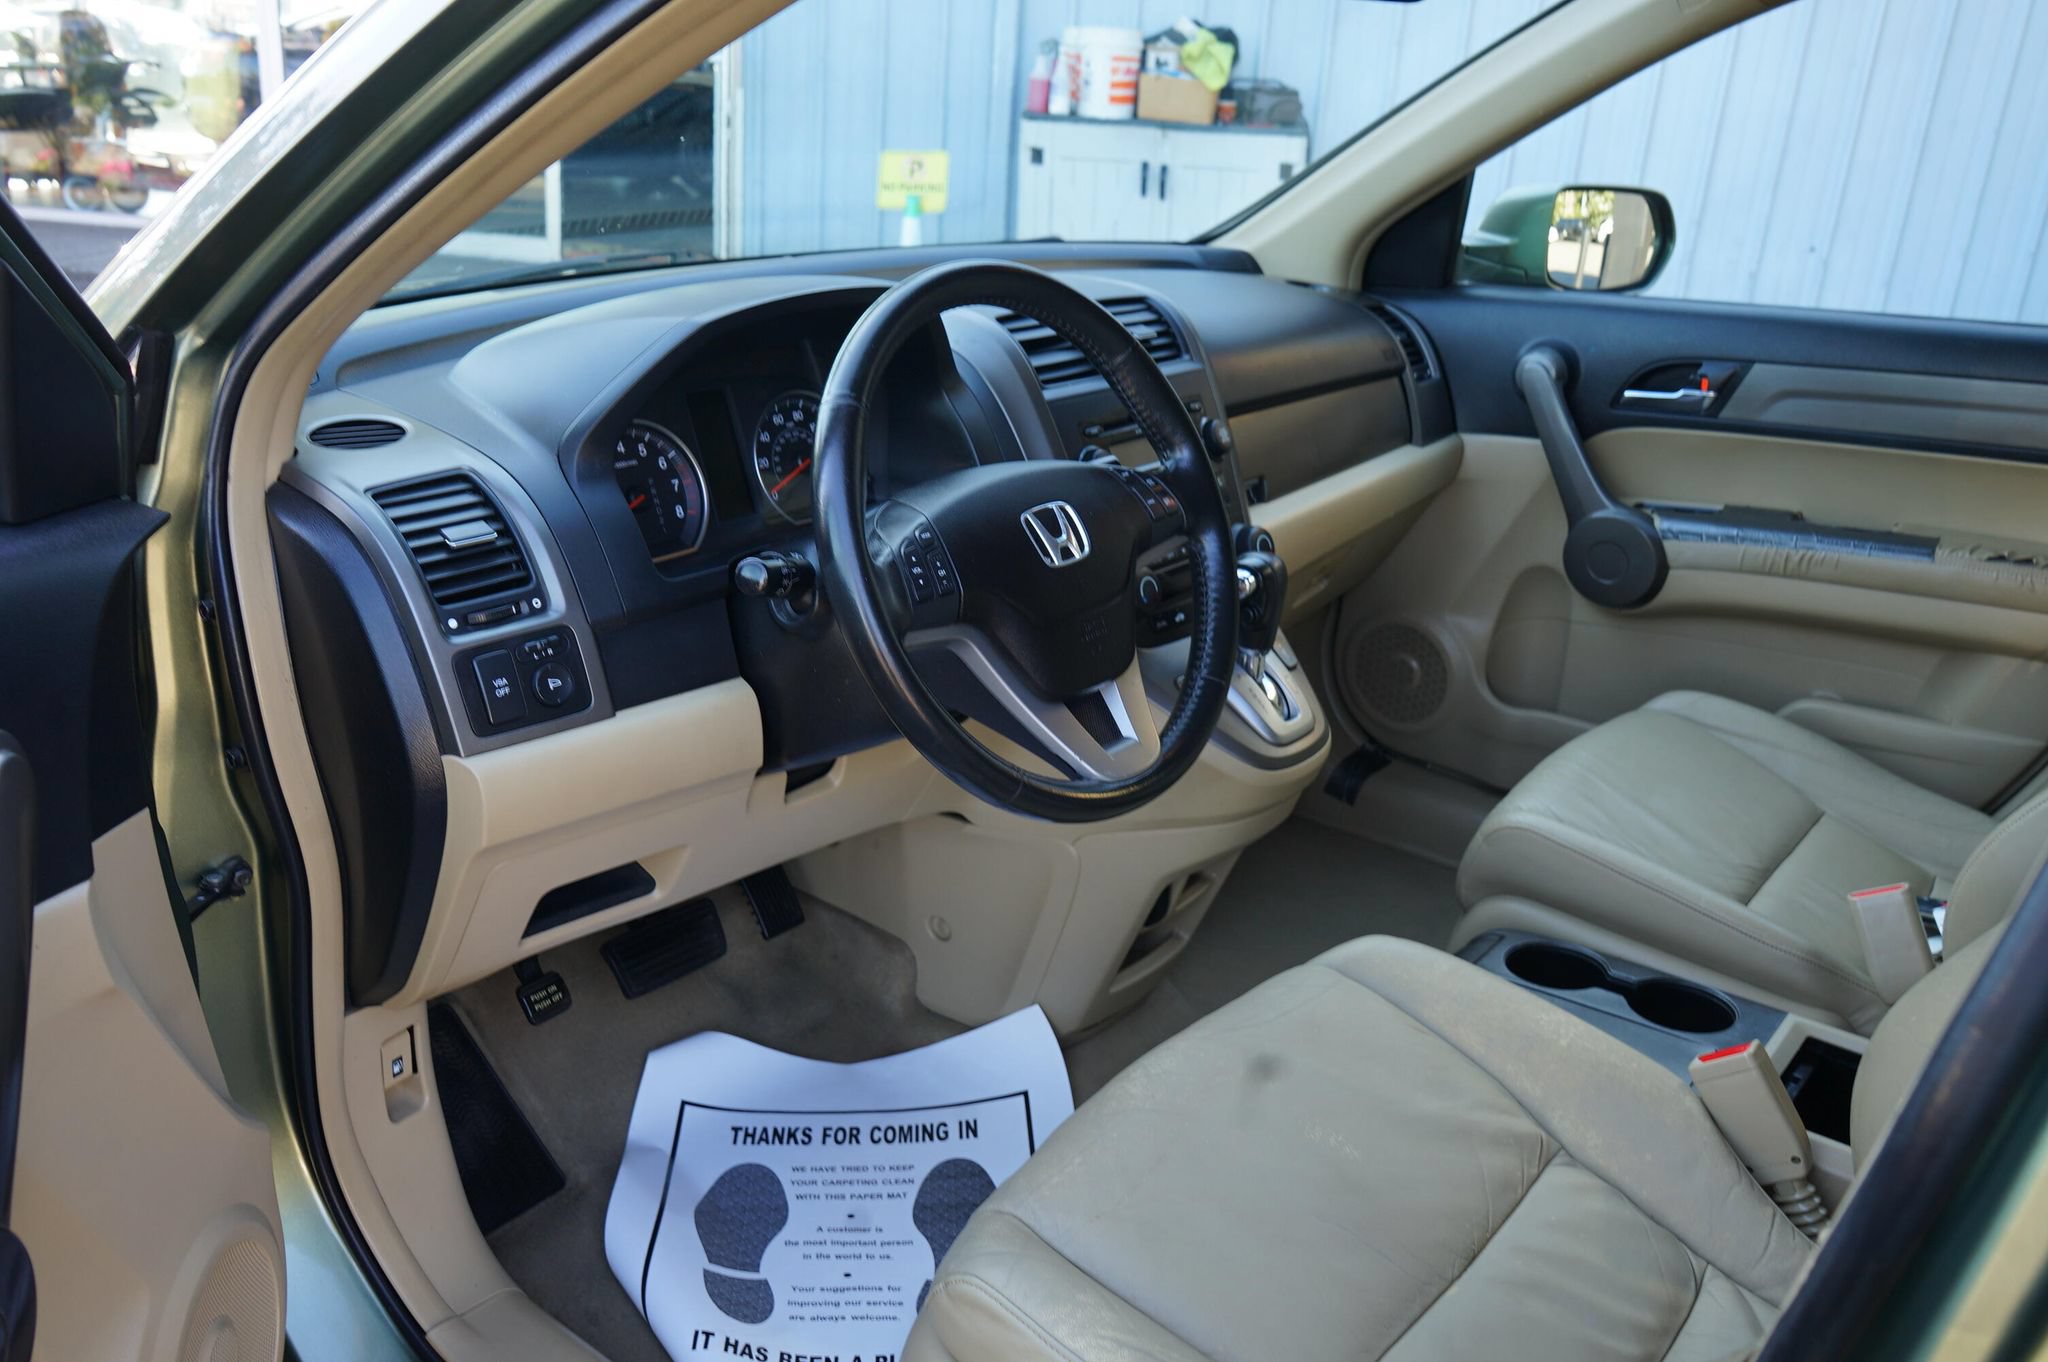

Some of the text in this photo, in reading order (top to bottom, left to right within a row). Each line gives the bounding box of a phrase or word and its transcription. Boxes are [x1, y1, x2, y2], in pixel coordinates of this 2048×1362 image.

[772, 414, 784, 426] 60
[792, 410, 804, 422] 80
[759, 432, 770, 443] 40
[616, 440, 626, 454] 4
[638, 442, 648, 458] 5
[658, 455, 668, 471] 6
[758, 457, 769, 469] 20
[671, 478, 680, 493] 7
[675, 504, 685, 519] 8
[495, 686, 511, 698] OFF
[530, 984, 558, 1002] PUSH ON
[534, 992, 563, 1011] PUSH OFF
[730, 1118, 978, 1146] THANKS FOR COMING IN
[820, 1285, 883, 1293] suggestions
[691, 1329, 716, 1350] IT
[723, 1336, 769, 1362] HAS
